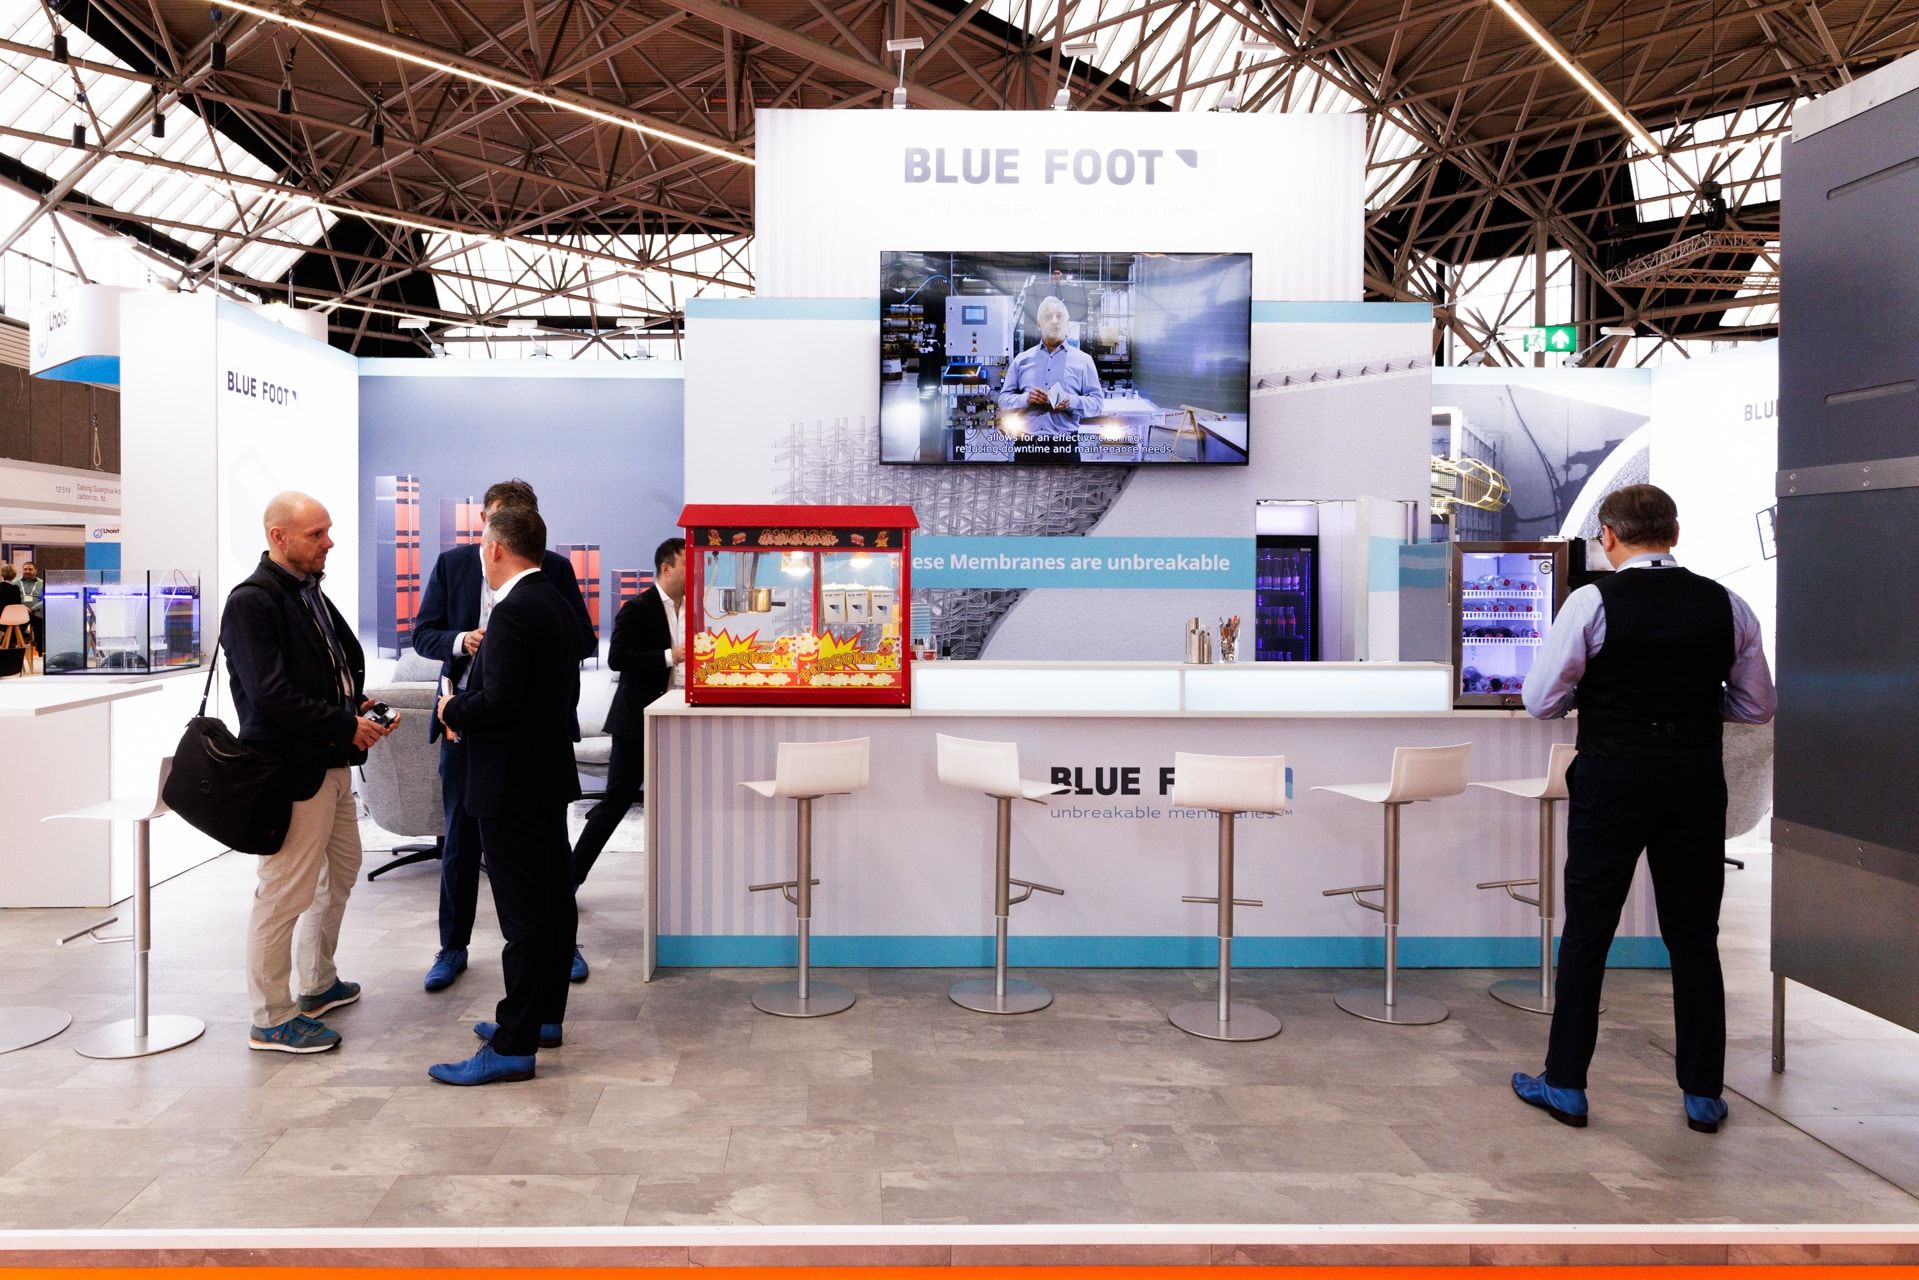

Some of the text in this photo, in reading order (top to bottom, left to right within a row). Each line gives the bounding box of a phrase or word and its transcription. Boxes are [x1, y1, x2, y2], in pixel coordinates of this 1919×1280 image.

[904, 147, 1164, 186] BLUE FOOT
[227, 370, 289, 407] BLUE FOOT
[1744, 399, 1778, 421] BLU
[988, 432, 1018, 442] allows
[1021, 432, 1035, 442] for
[1037, 434, 1050, 442] an
[1052, 432, 1095, 442] effective
[955, 444, 999, 455] reducing
[1001, 444, 1050, 454] downtime
[1053, 444, 1071, 454] and
[1074, 444, 1139, 454] maintenance
[912, 553, 1230, 570] ese Membranes are unbreakable
[1050, 766, 1141, 796] BLUE
[1050, 805, 1161, 819] unbreakable
